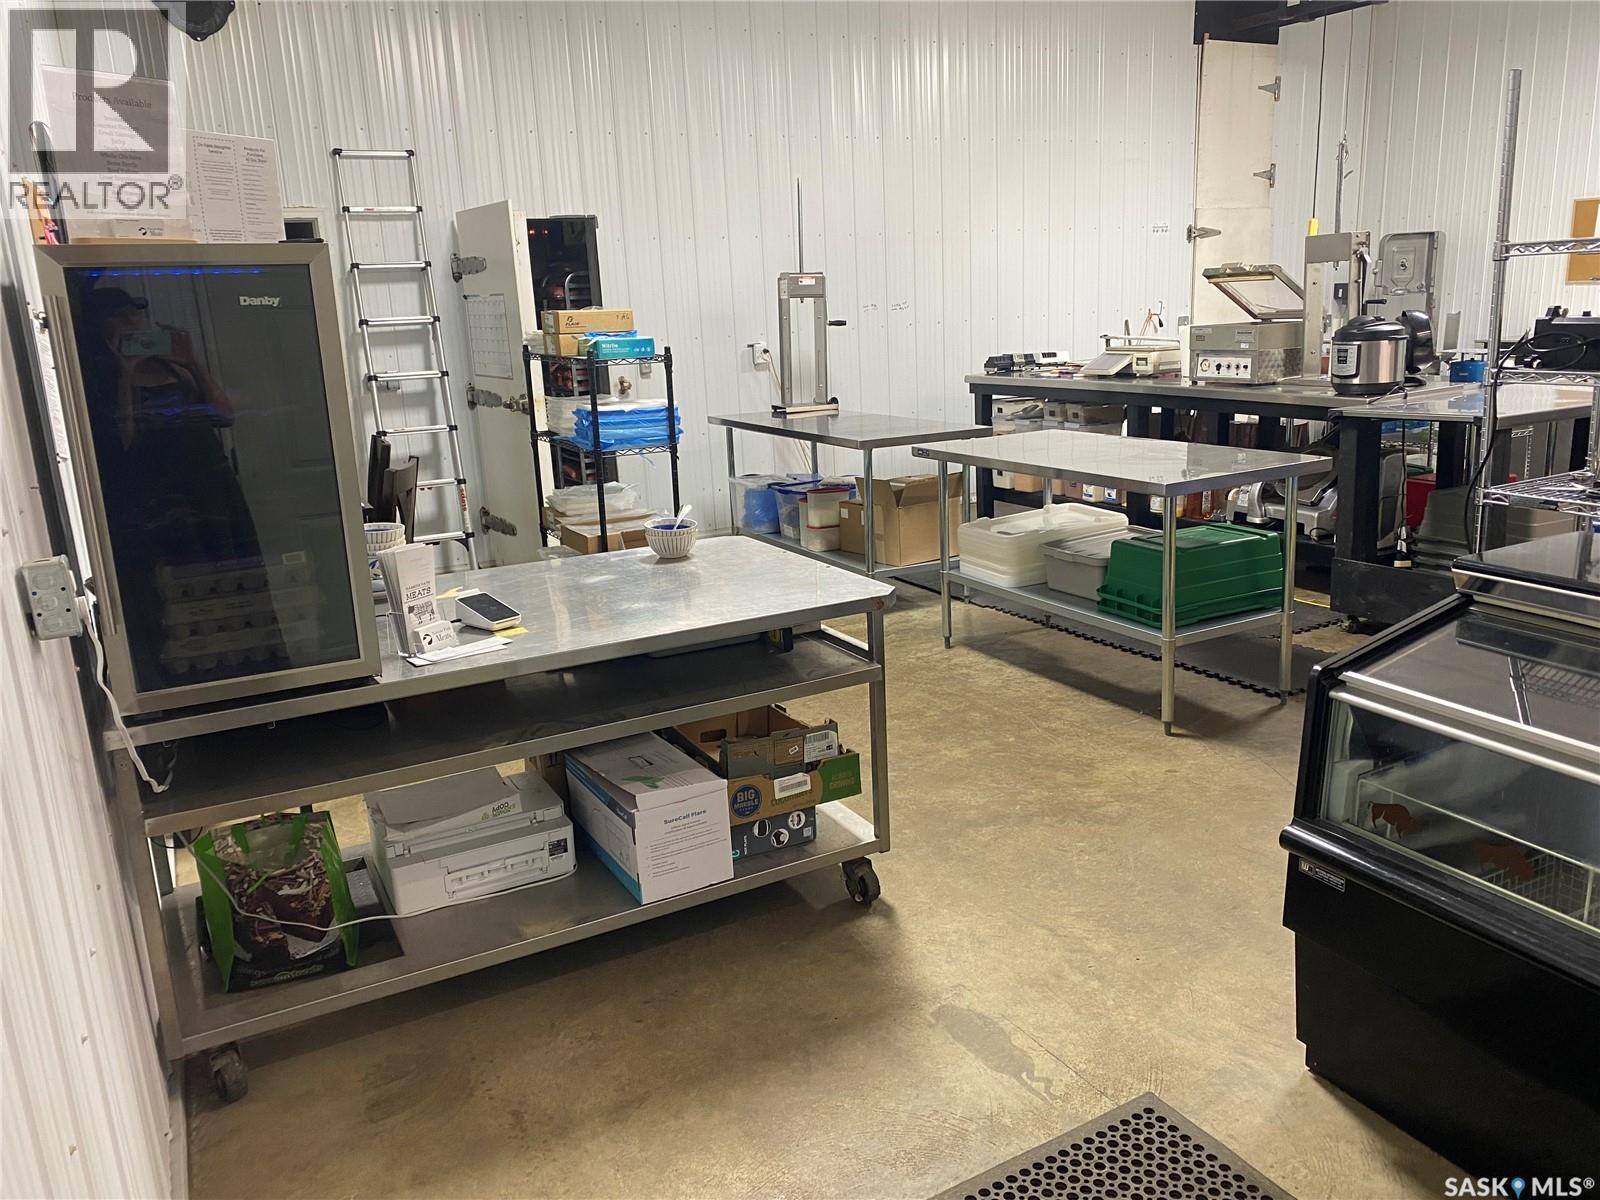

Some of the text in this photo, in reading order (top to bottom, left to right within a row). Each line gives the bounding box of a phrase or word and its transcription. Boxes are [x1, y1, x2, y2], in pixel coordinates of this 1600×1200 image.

[239, 295, 280, 307] Danby
[406, 586, 432, 601] MEATS
[736, 788, 756, 800] BIG
[491, 801, 510, 814] COPY
[663, 809, 707, 825] SureCall Flare
